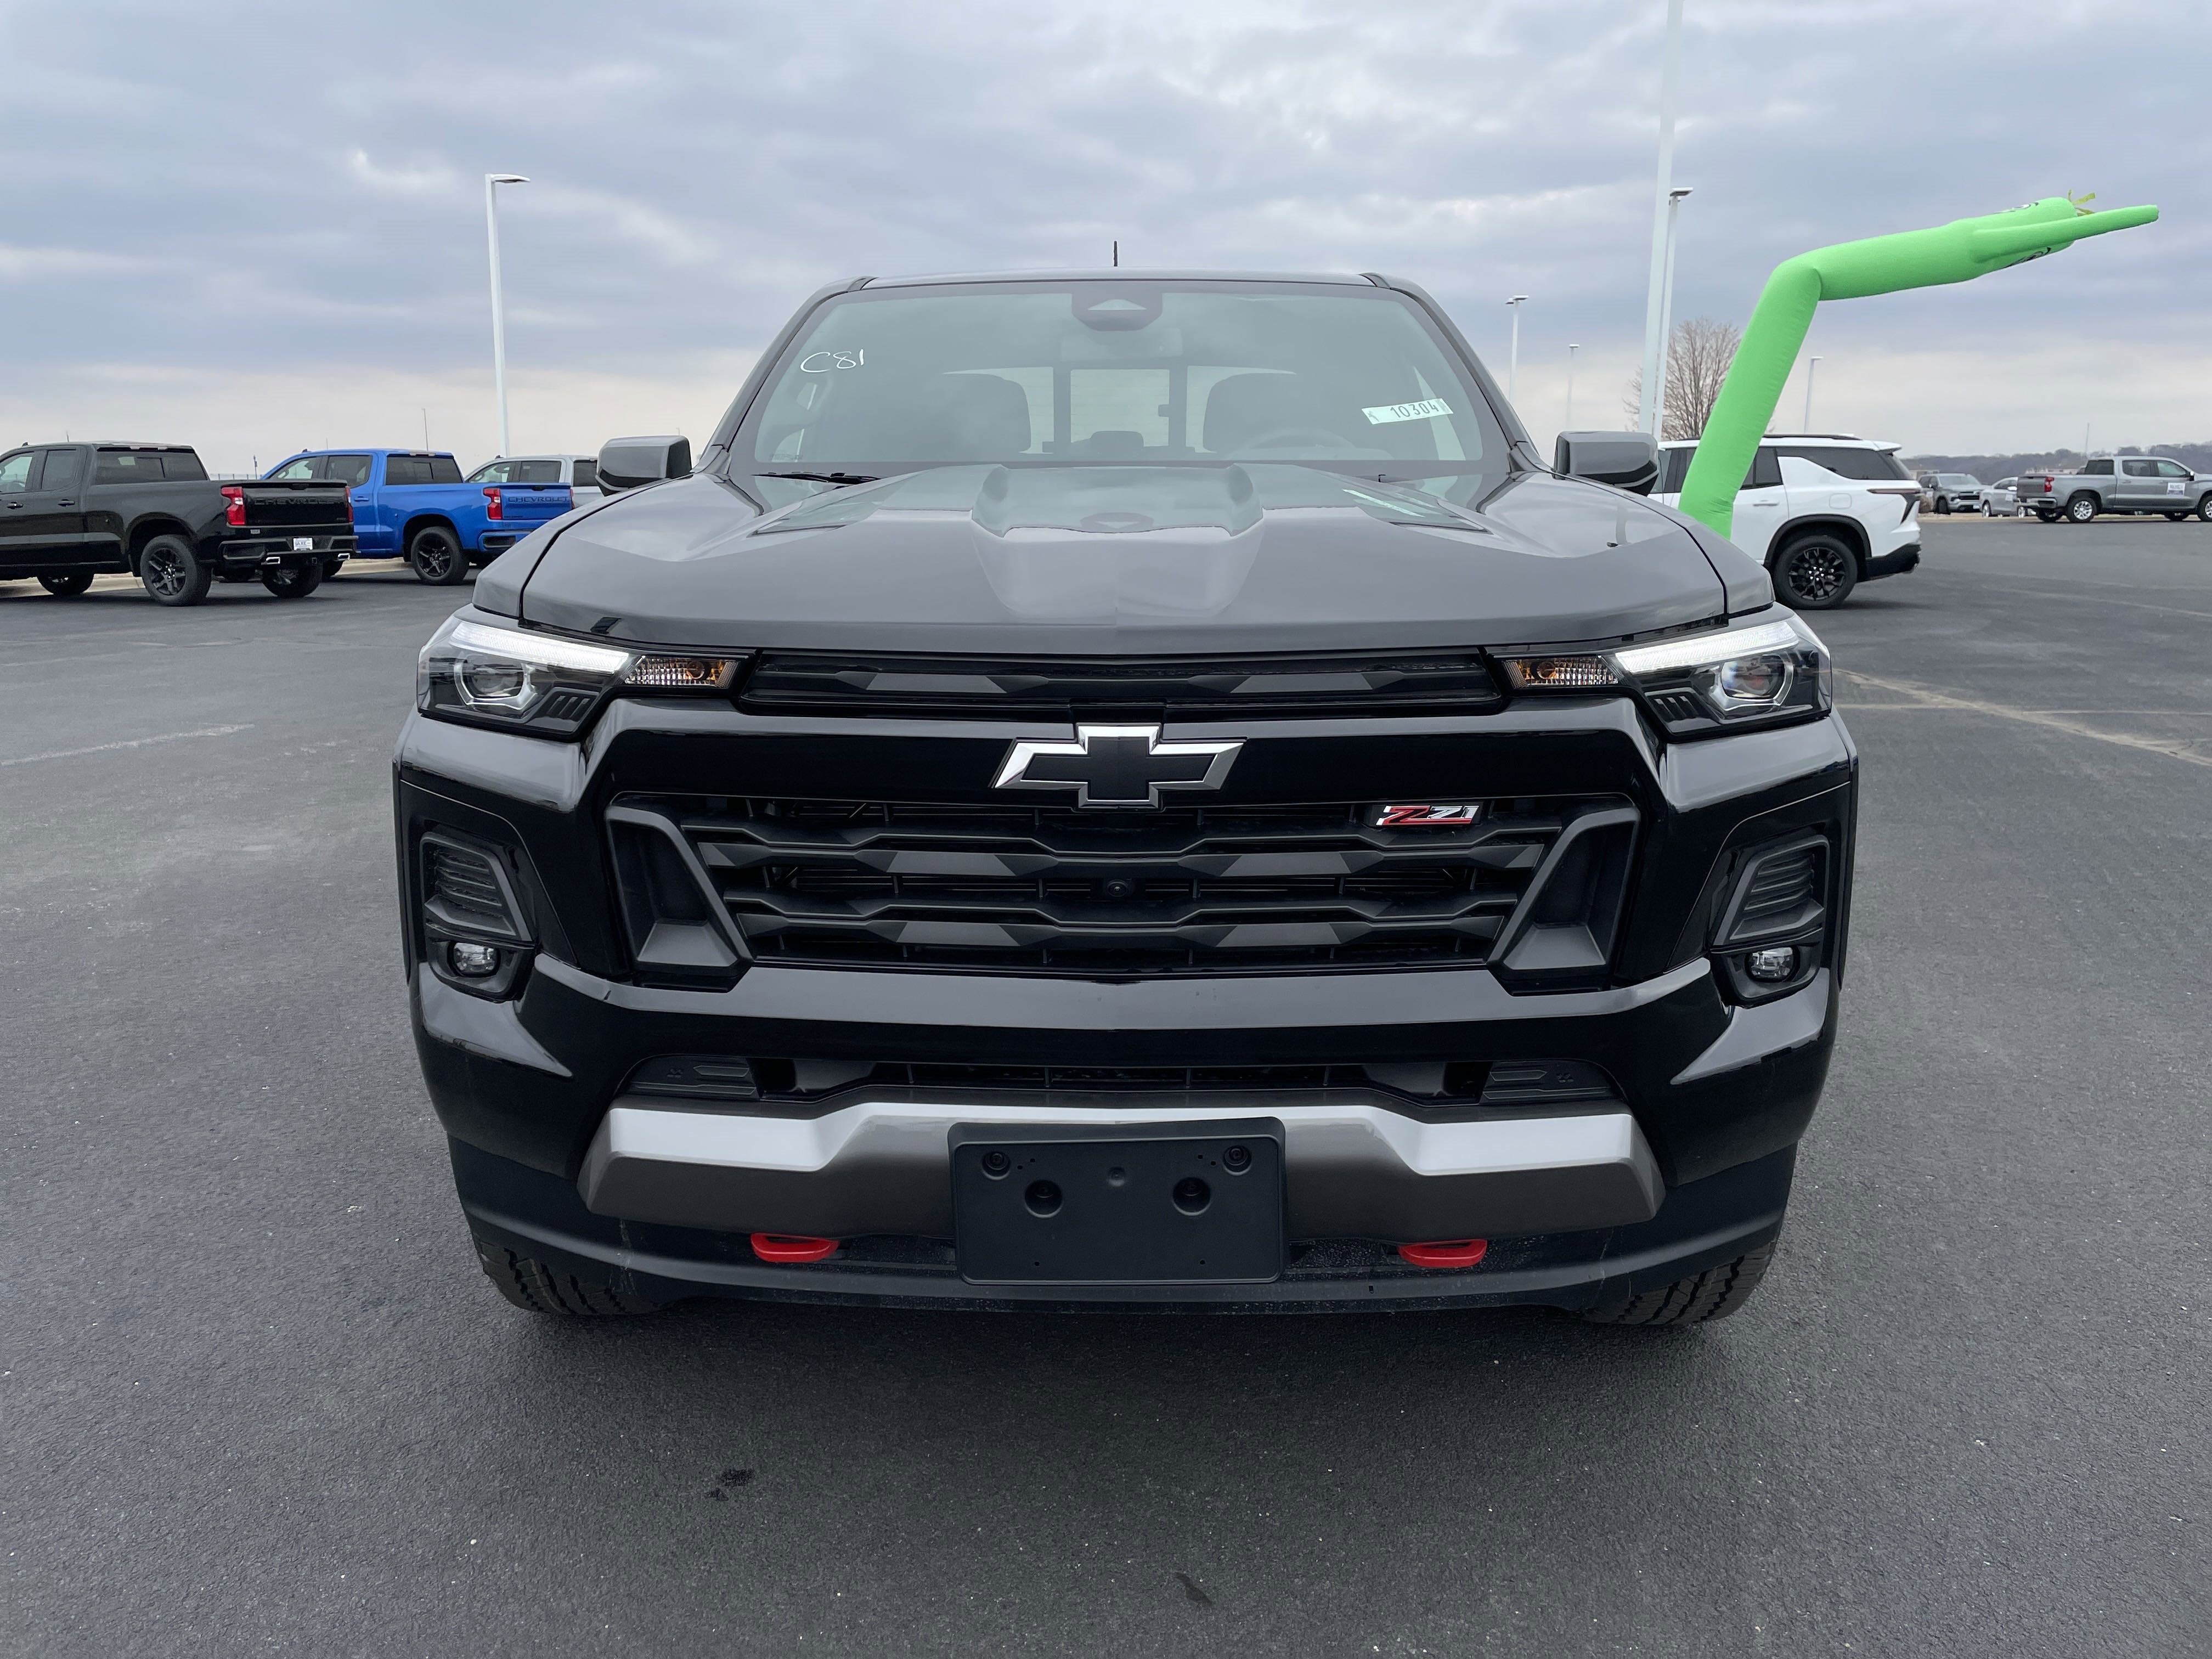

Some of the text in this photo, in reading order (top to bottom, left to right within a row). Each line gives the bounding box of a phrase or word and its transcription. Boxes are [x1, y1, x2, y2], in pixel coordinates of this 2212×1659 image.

[800, 349, 864, 373] C81
[1390, 401, 1439, 418] 10304
[1376, 805, 1480, 825] Z71
